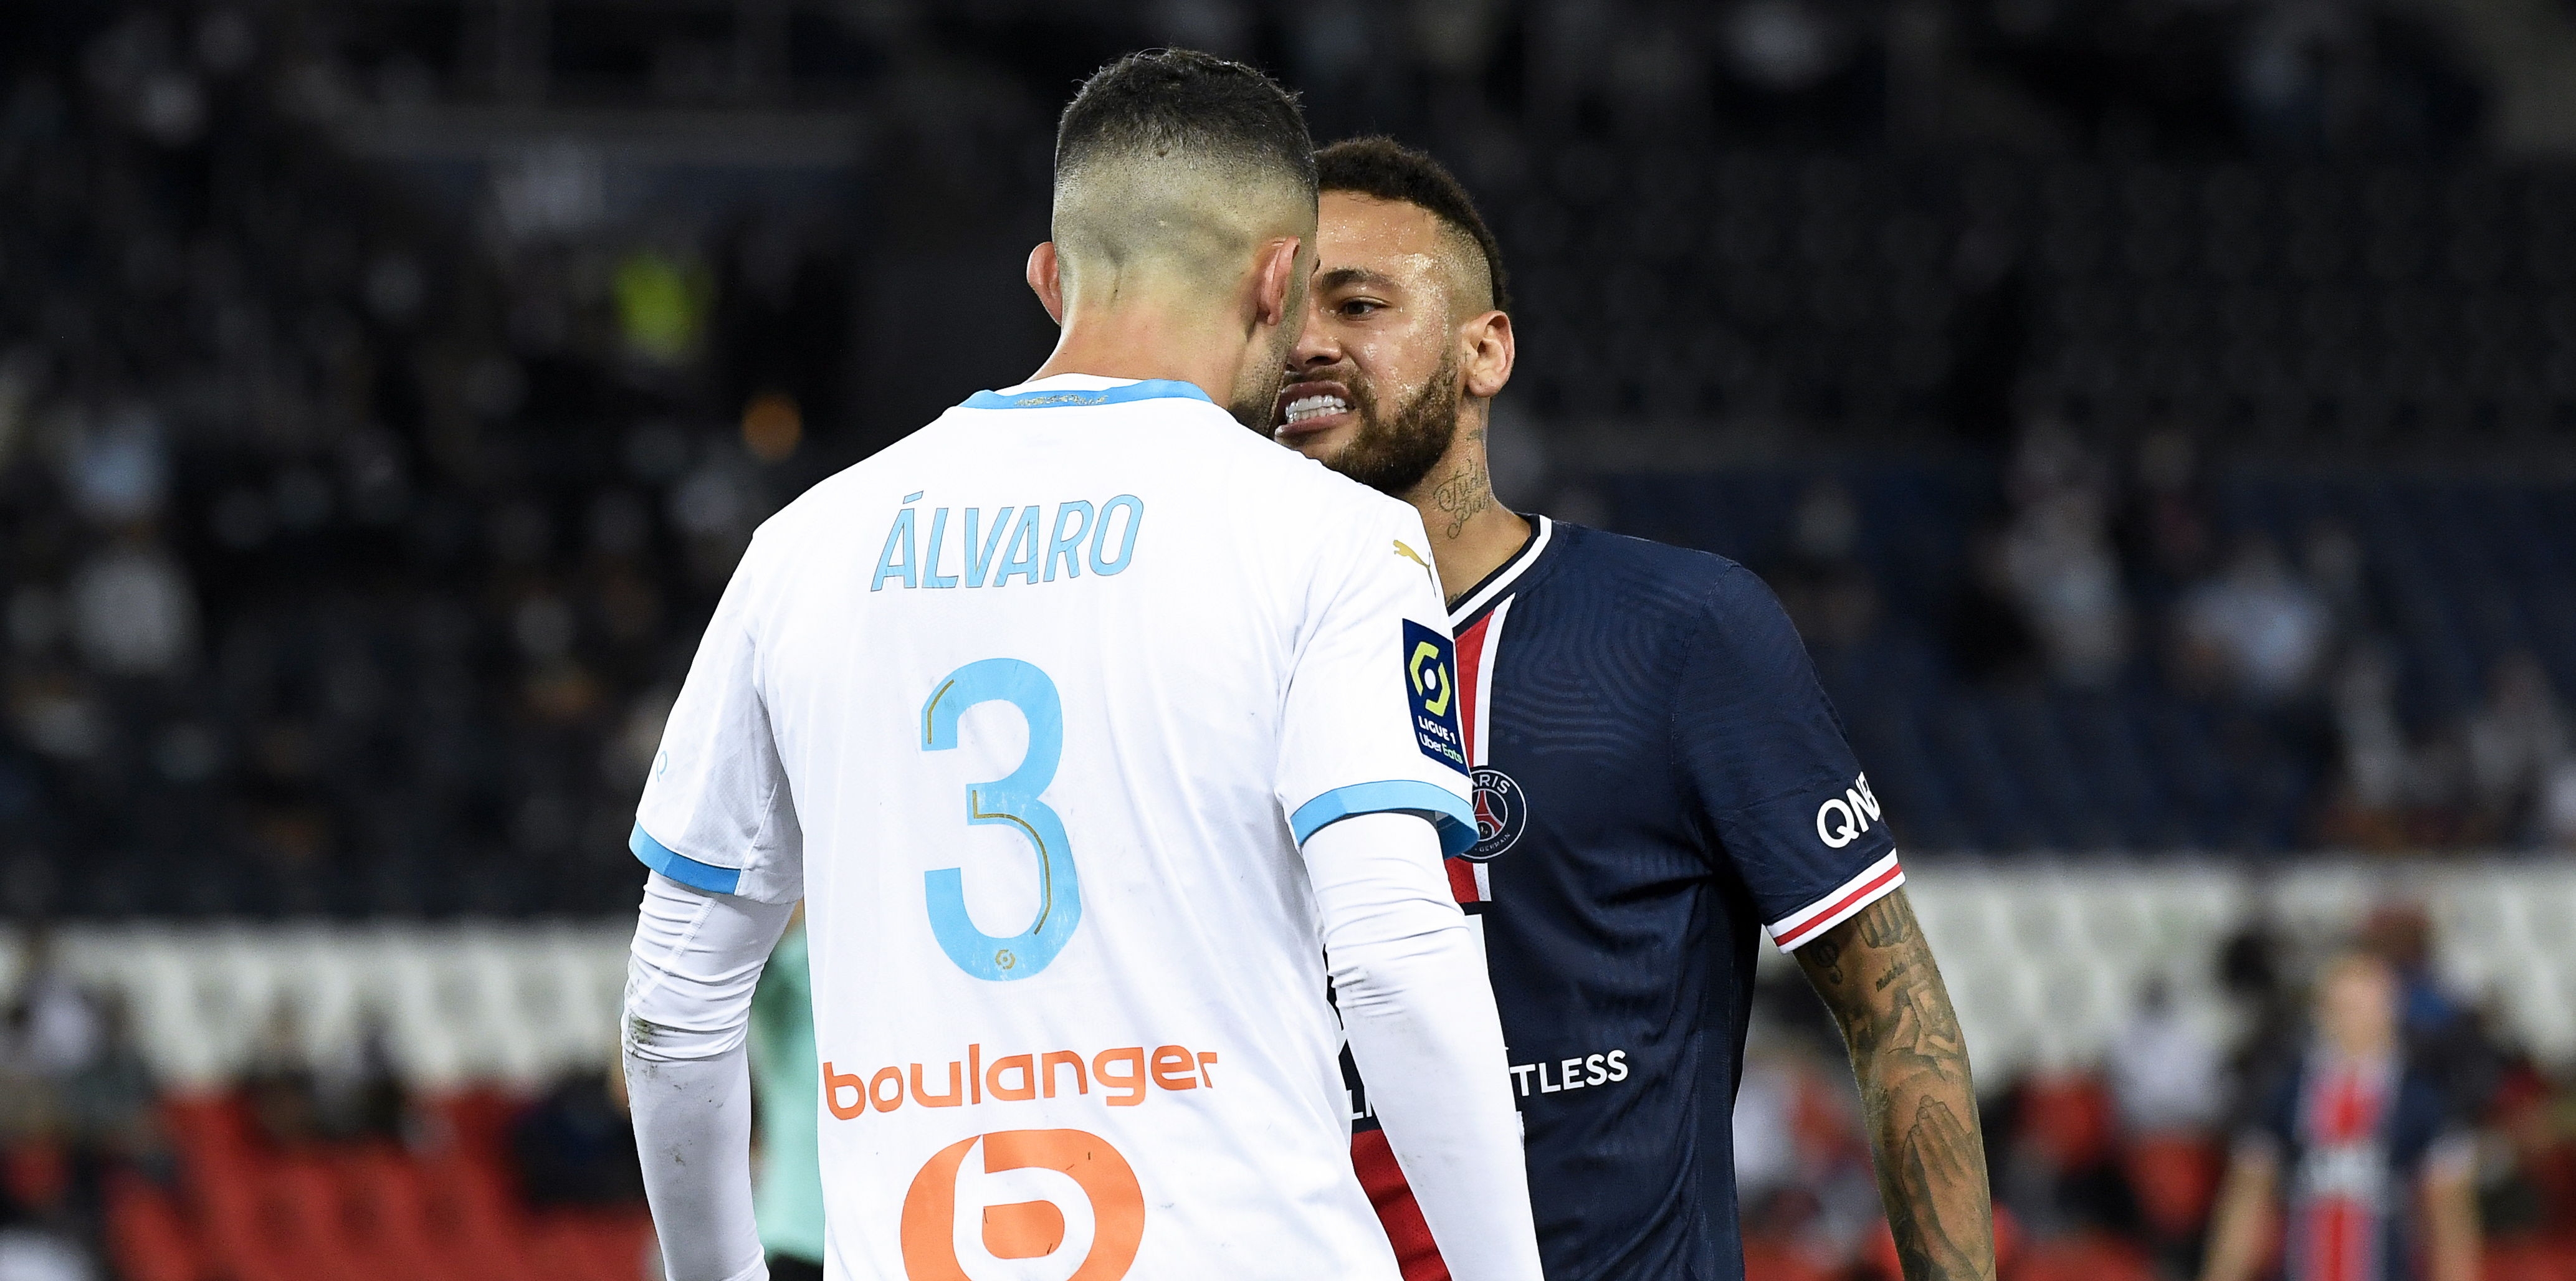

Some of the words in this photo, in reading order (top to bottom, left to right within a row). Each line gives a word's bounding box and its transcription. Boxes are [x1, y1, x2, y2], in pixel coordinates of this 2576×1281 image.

[871, 490, 1144, 591] ÁLVARO
[1418, 715, 1450, 741] LIGUE
[1449, 732, 1456, 745] 1
[1419, 732, 1442, 753] Uber
[1441, 743, 1464, 764] Eats
[1472, 774, 1510, 794] RIS
[921, 658, 1082, 981] 3
[1817, 771, 1880, 848] QNB
[1479, 832, 1510, 852] GERMAIN
[823, 1044, 1218, 1120] boulanger
[1509, 1049, 1628, 1097] TLESS
